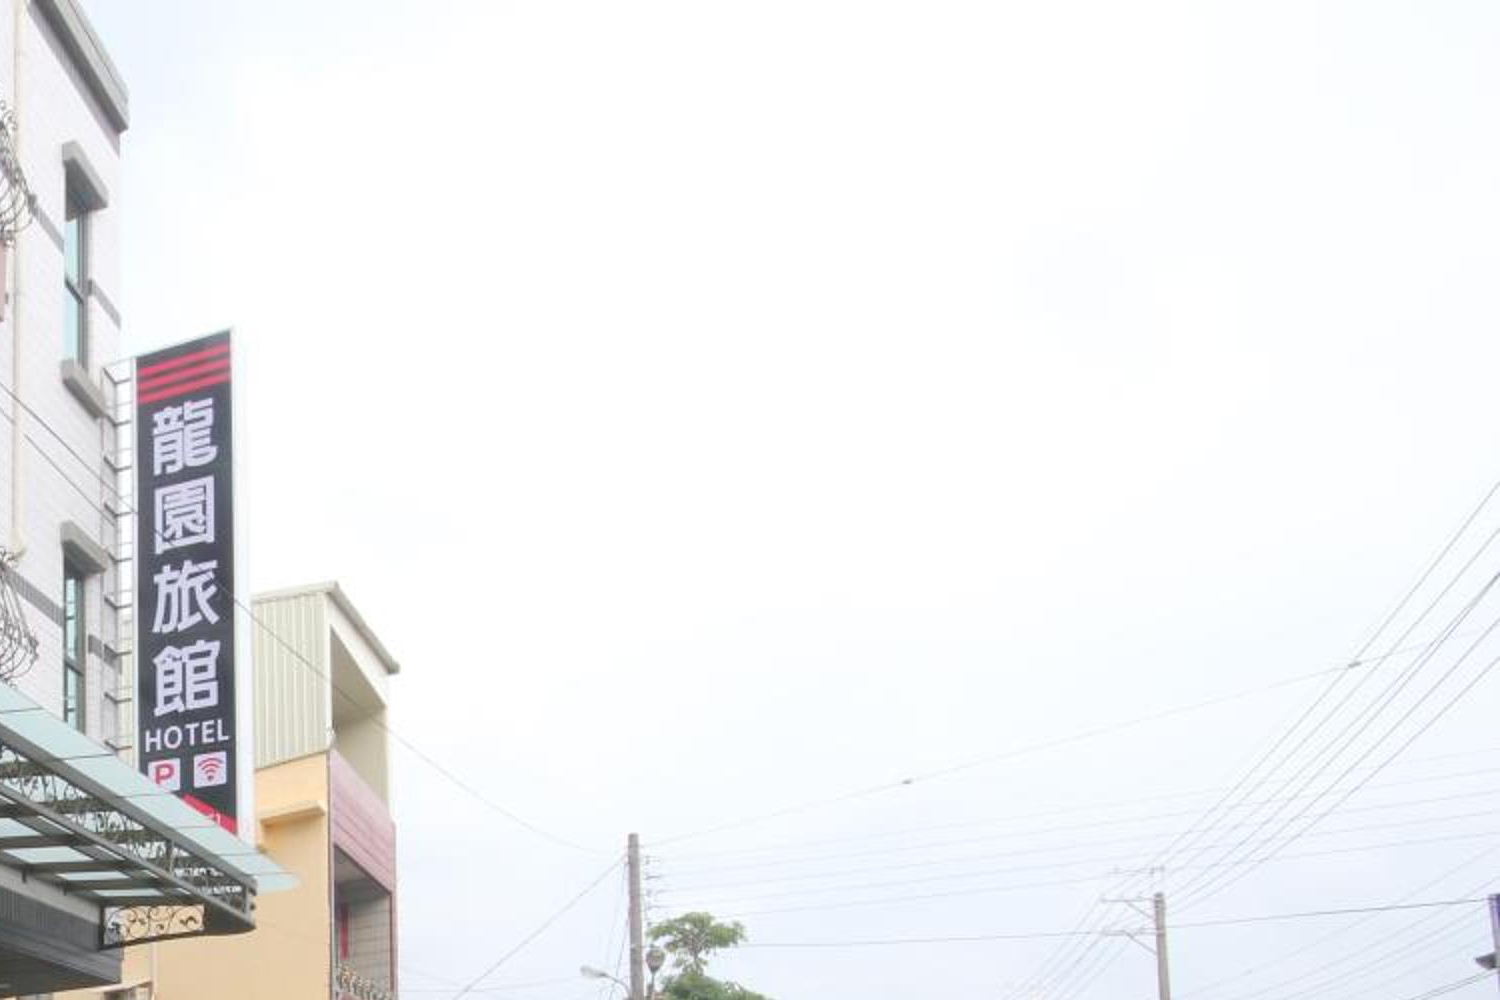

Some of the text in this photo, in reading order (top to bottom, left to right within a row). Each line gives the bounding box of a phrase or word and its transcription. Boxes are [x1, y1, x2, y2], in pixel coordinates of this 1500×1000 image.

[152, 397, 220, 717] 龍園旅館
[145, 718, 229, 753] HOTEL
[155, 763, 175, 785] P
